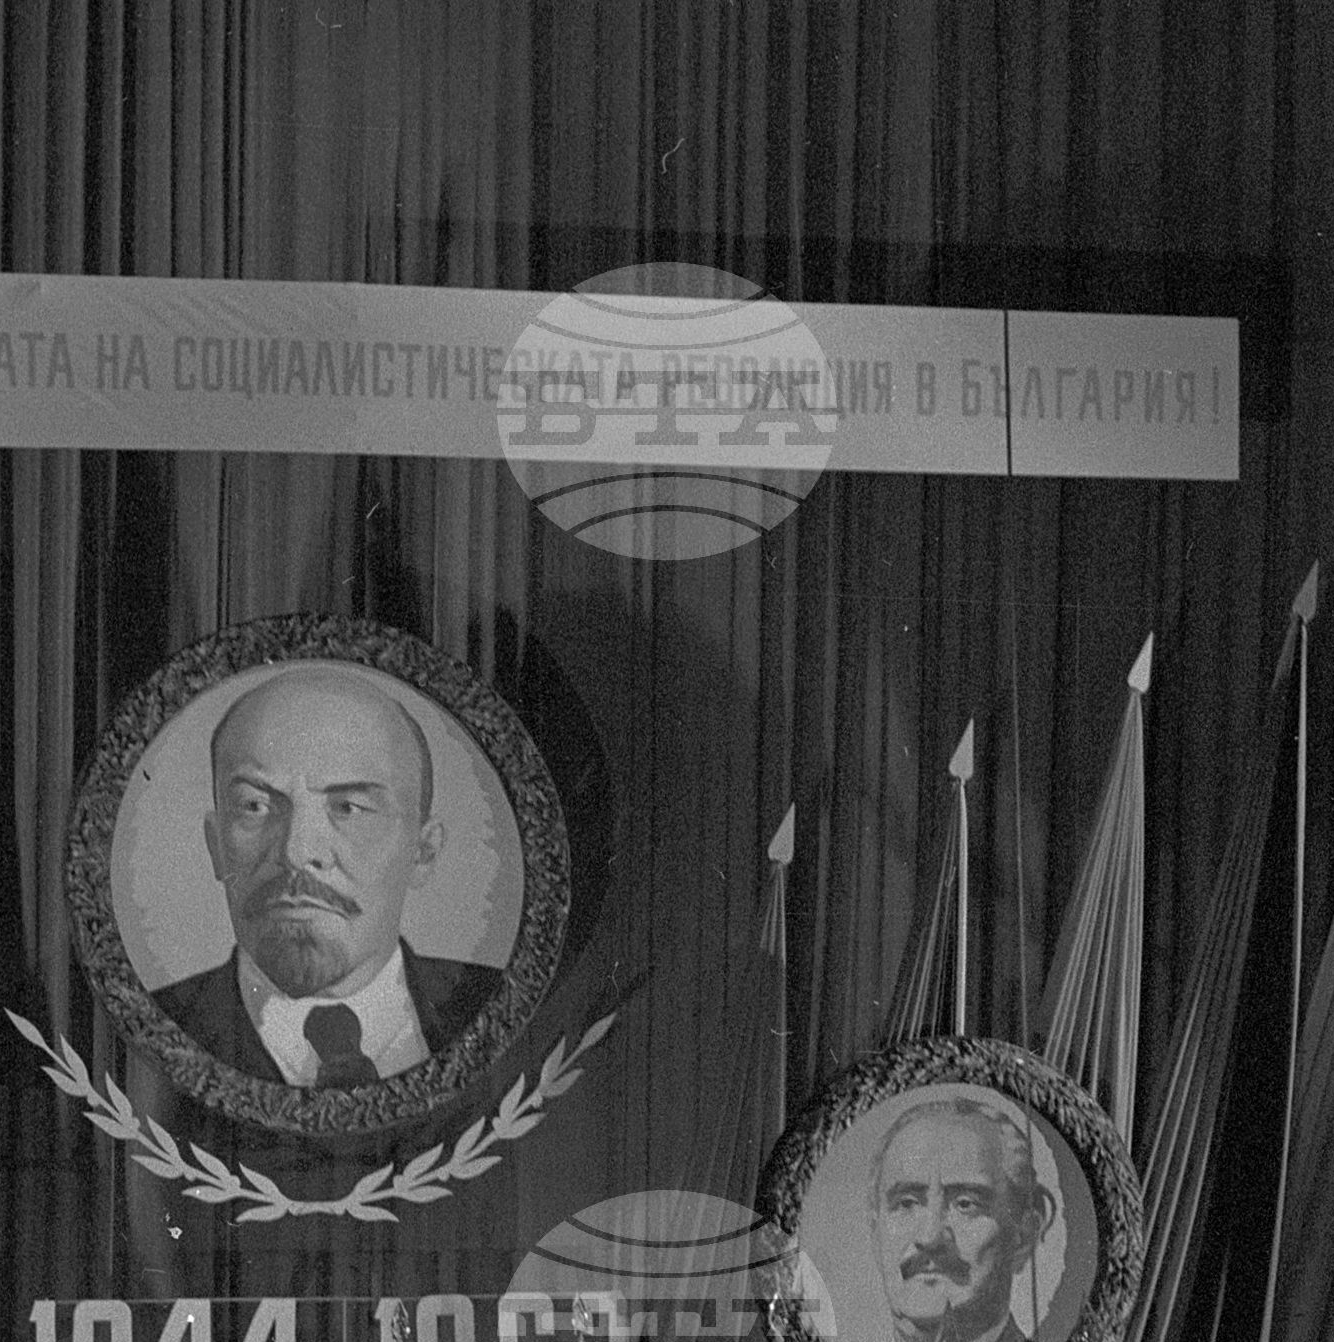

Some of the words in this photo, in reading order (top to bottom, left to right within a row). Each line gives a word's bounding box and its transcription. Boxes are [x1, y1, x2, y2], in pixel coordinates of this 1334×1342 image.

[96, 332, 150, 390] НА
[173, 335, 639, 410] СОЦИАЛИСТИЧЕСКАТА
[917, 361, 936, 417] В
